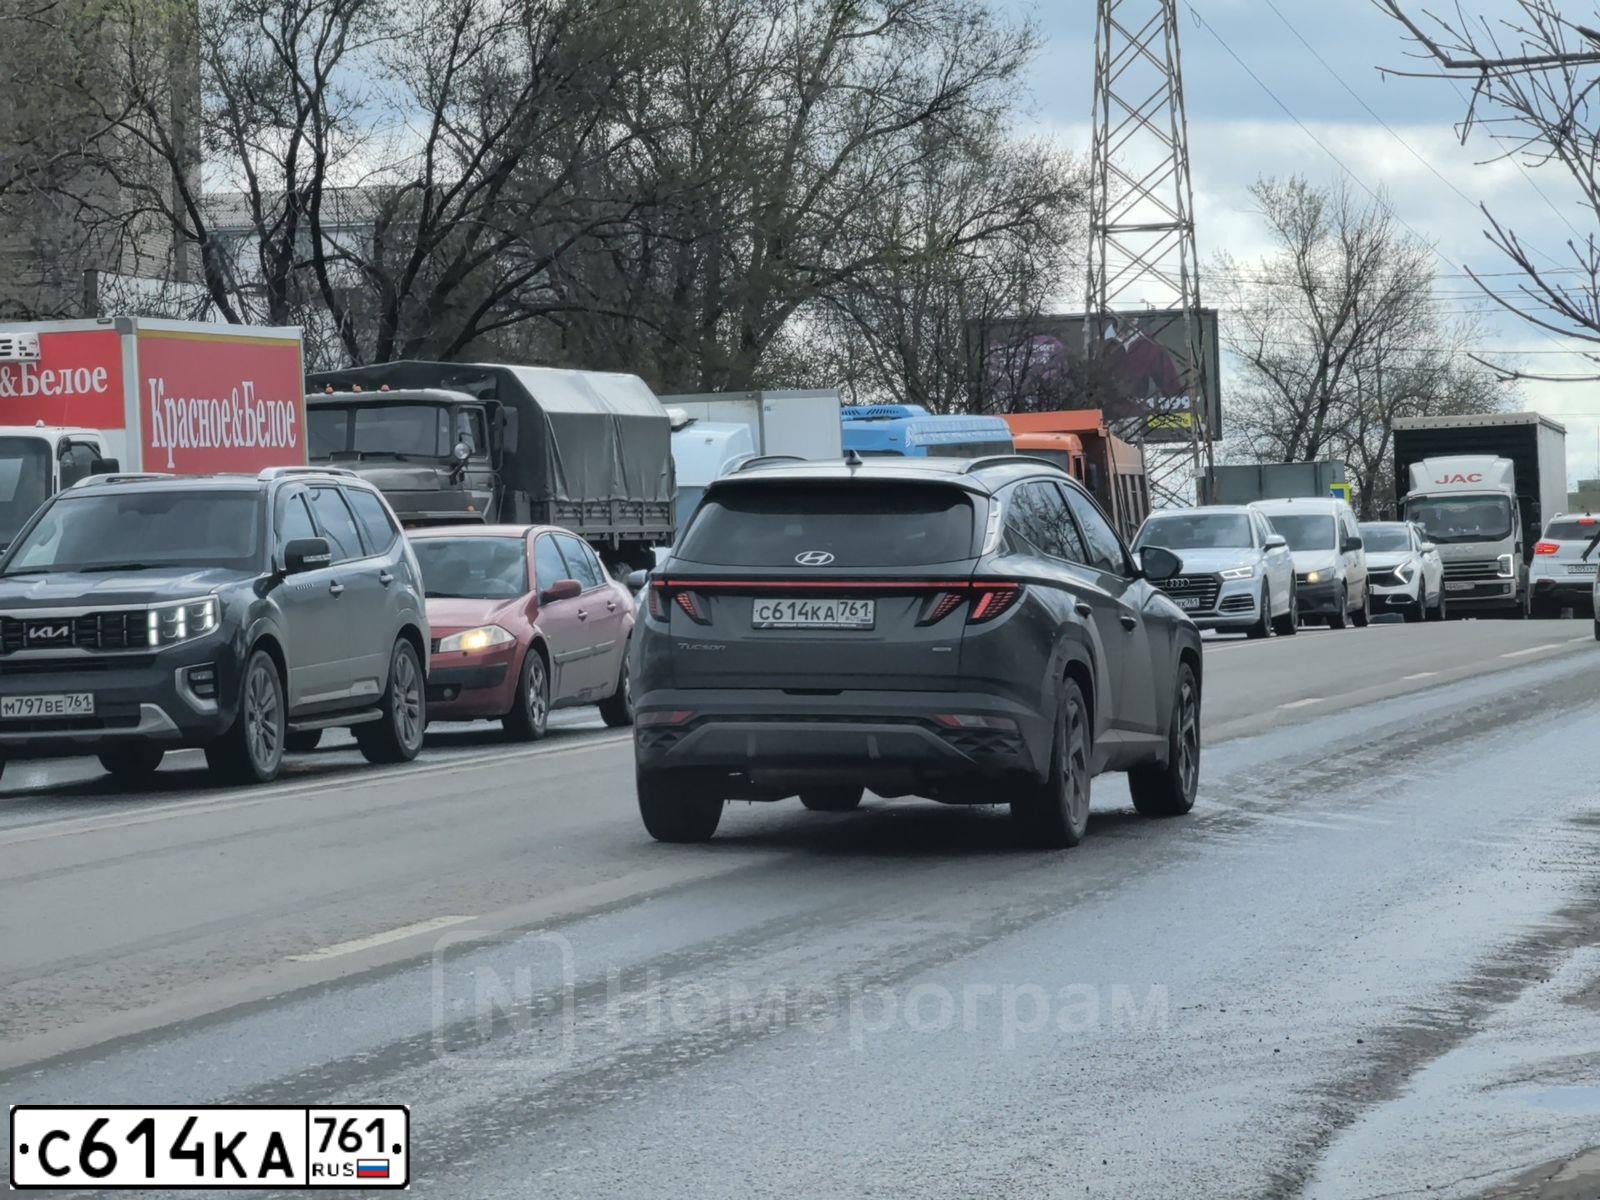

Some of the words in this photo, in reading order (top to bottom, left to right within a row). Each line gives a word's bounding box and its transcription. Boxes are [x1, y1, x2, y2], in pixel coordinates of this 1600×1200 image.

[148, 377, 297, 469] Красное&Белое
[1434, 473, 1483, 485] JAC
[759, 601, 835, 621] С614КА
[840, 601, 869, 617] 761
[29, 625, 69, 639] KIA
[3, 698, 64, 715] М797ВЕ
[65, 694, 91, 708] 761
